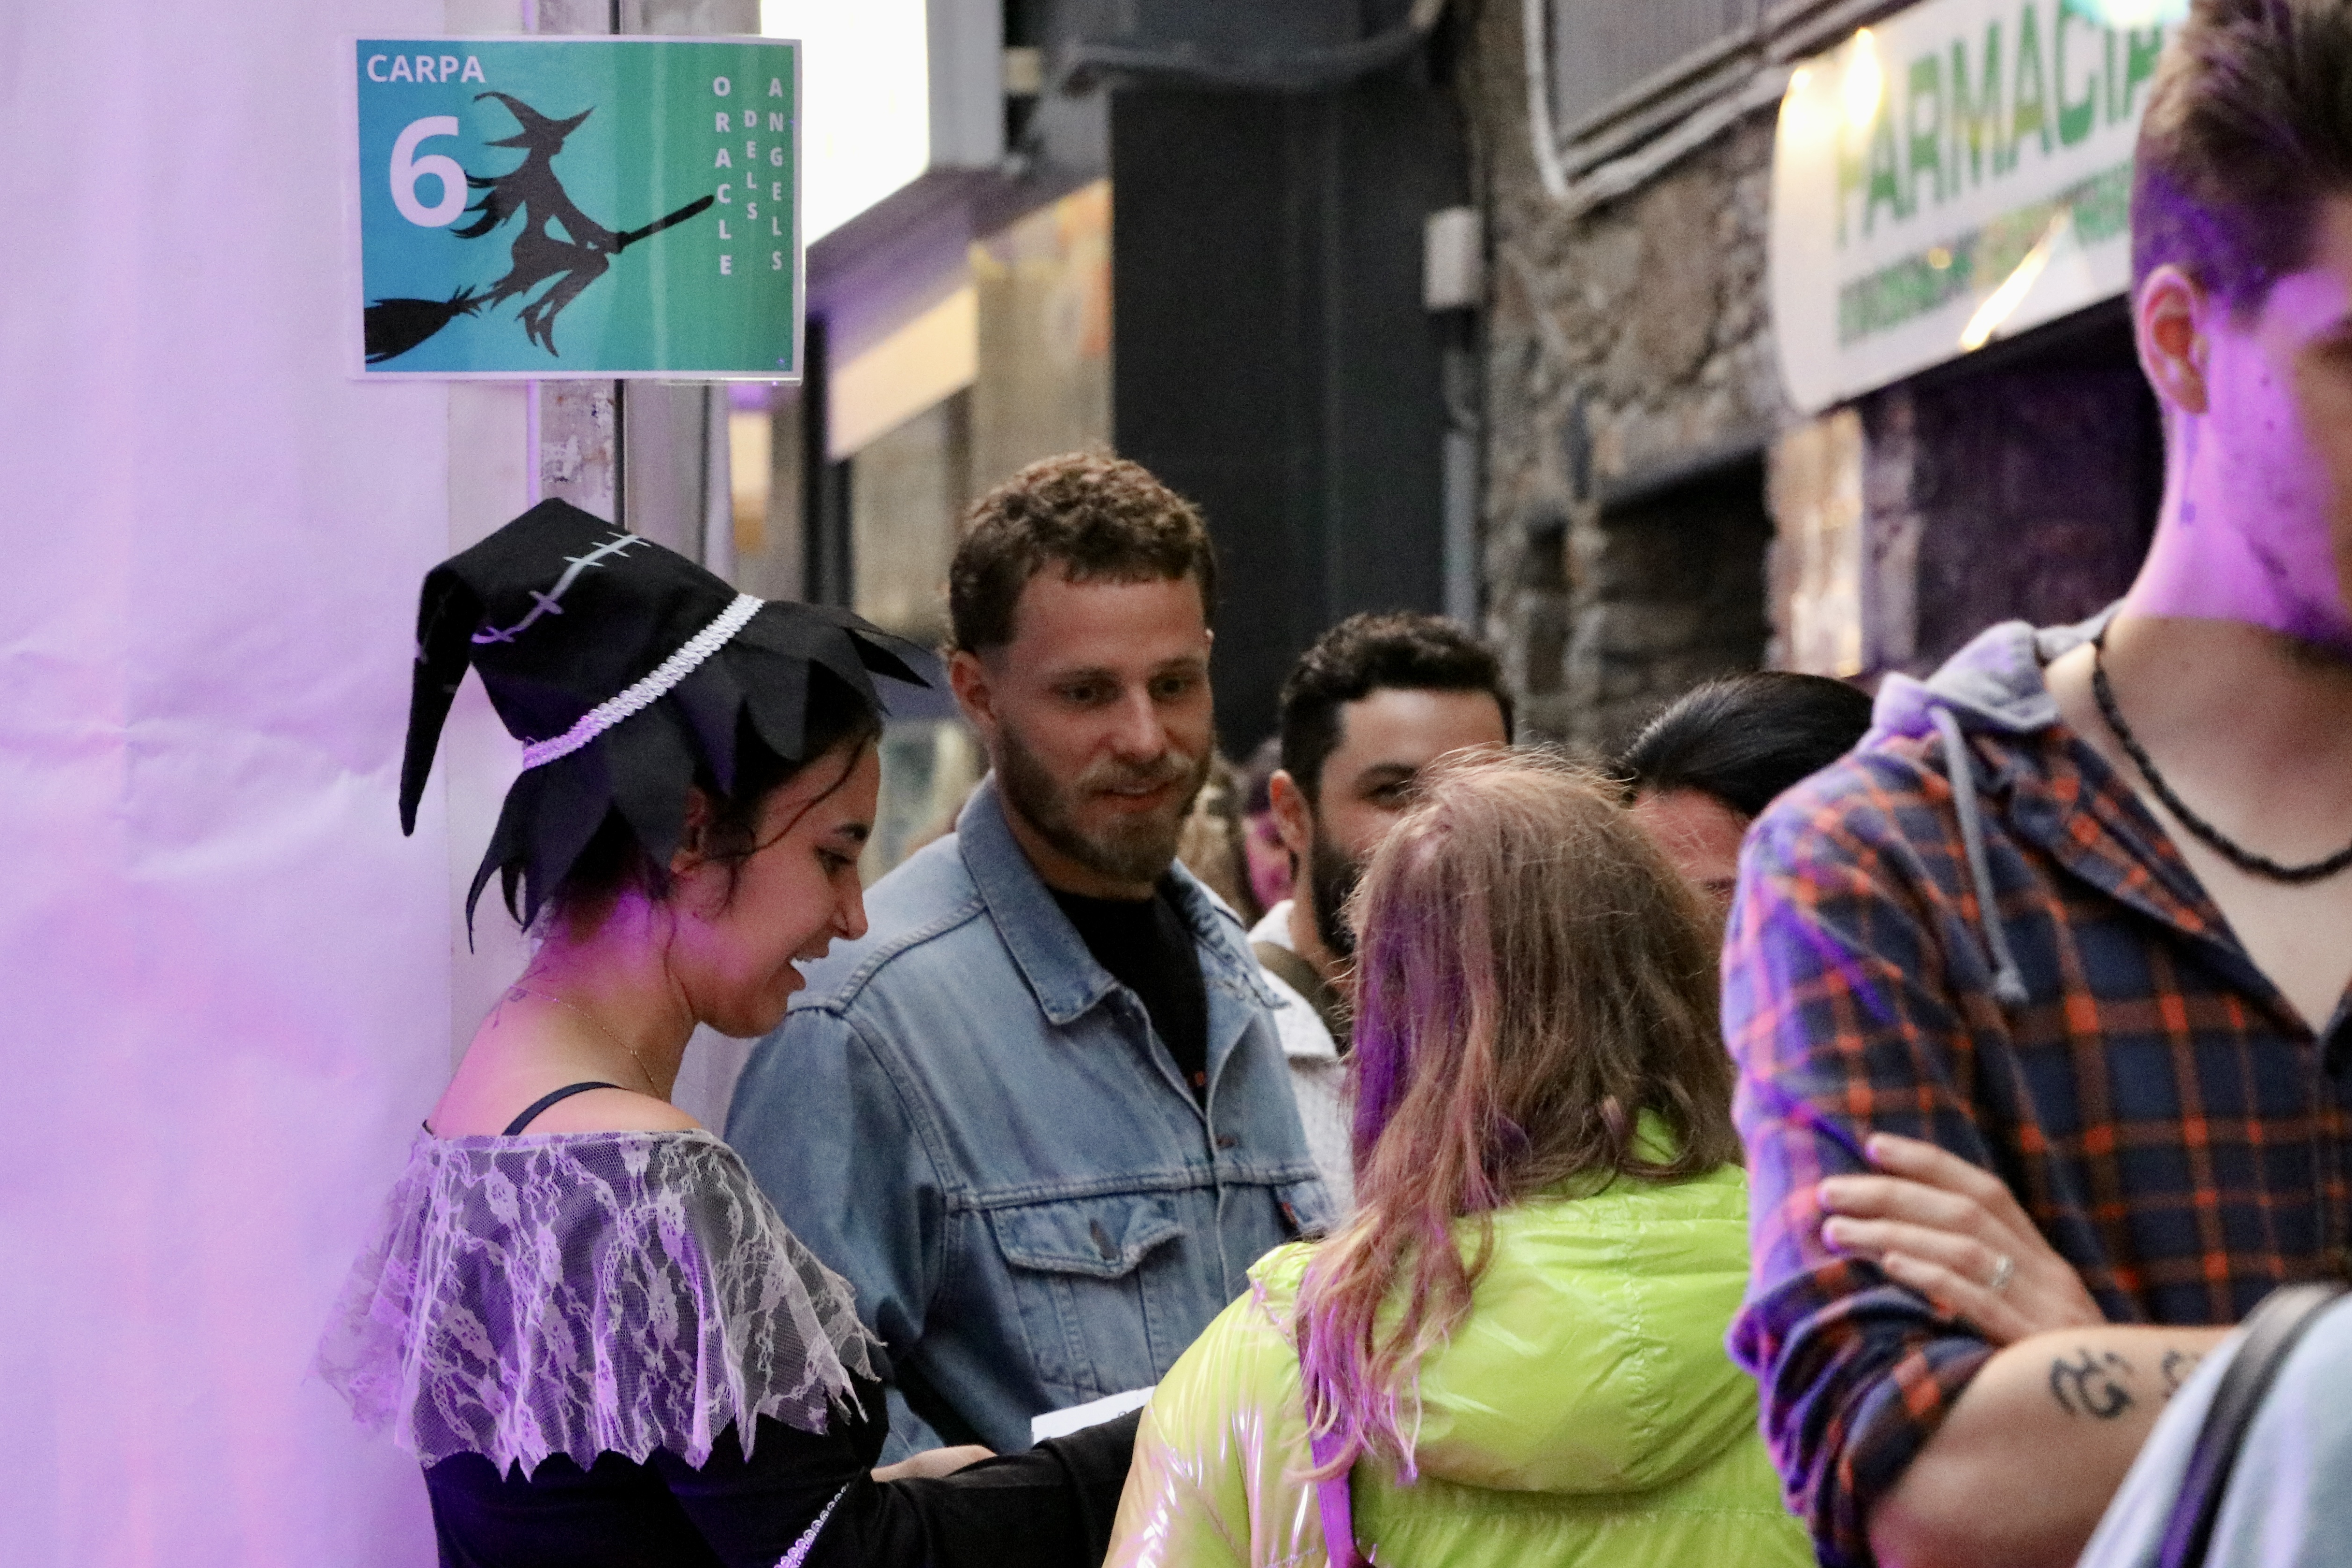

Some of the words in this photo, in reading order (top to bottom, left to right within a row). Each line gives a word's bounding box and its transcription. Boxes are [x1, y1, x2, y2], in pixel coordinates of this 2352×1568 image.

[367, 54, 486, 83] CARPA
[390, 116, 468, 227] 6
[713, 76, 732, 275] ORACLE
[744, 110, 758, 220] DELS
[768, 78, 783, 270] ANGELS
